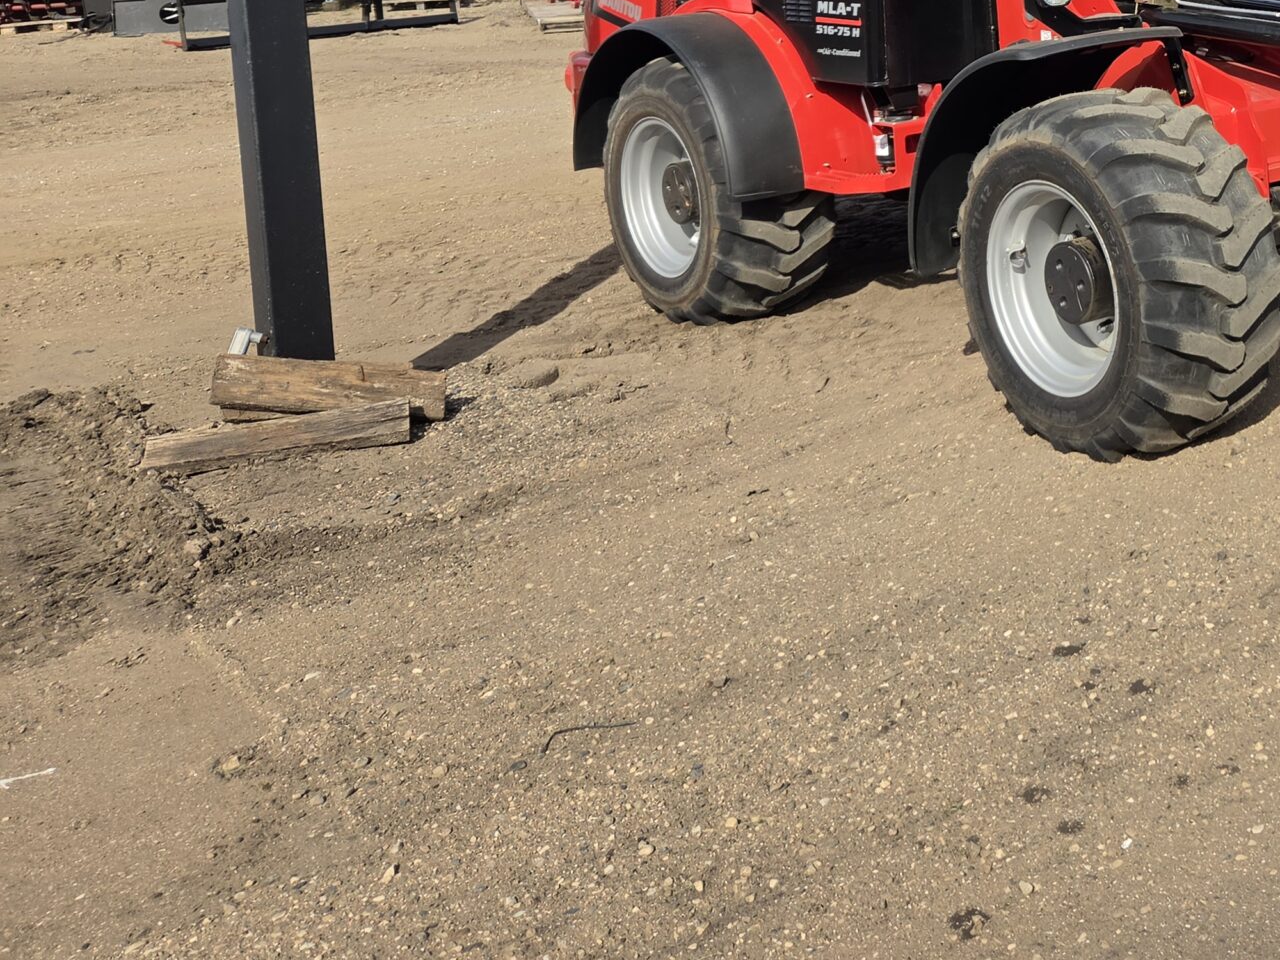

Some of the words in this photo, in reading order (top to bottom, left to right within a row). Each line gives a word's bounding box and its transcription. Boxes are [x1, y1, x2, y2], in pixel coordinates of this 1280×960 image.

[816, 0, 861, 16] MLA-T
[815, 24, 851, 37] 516-75
[851, 27, 860, 38] H
